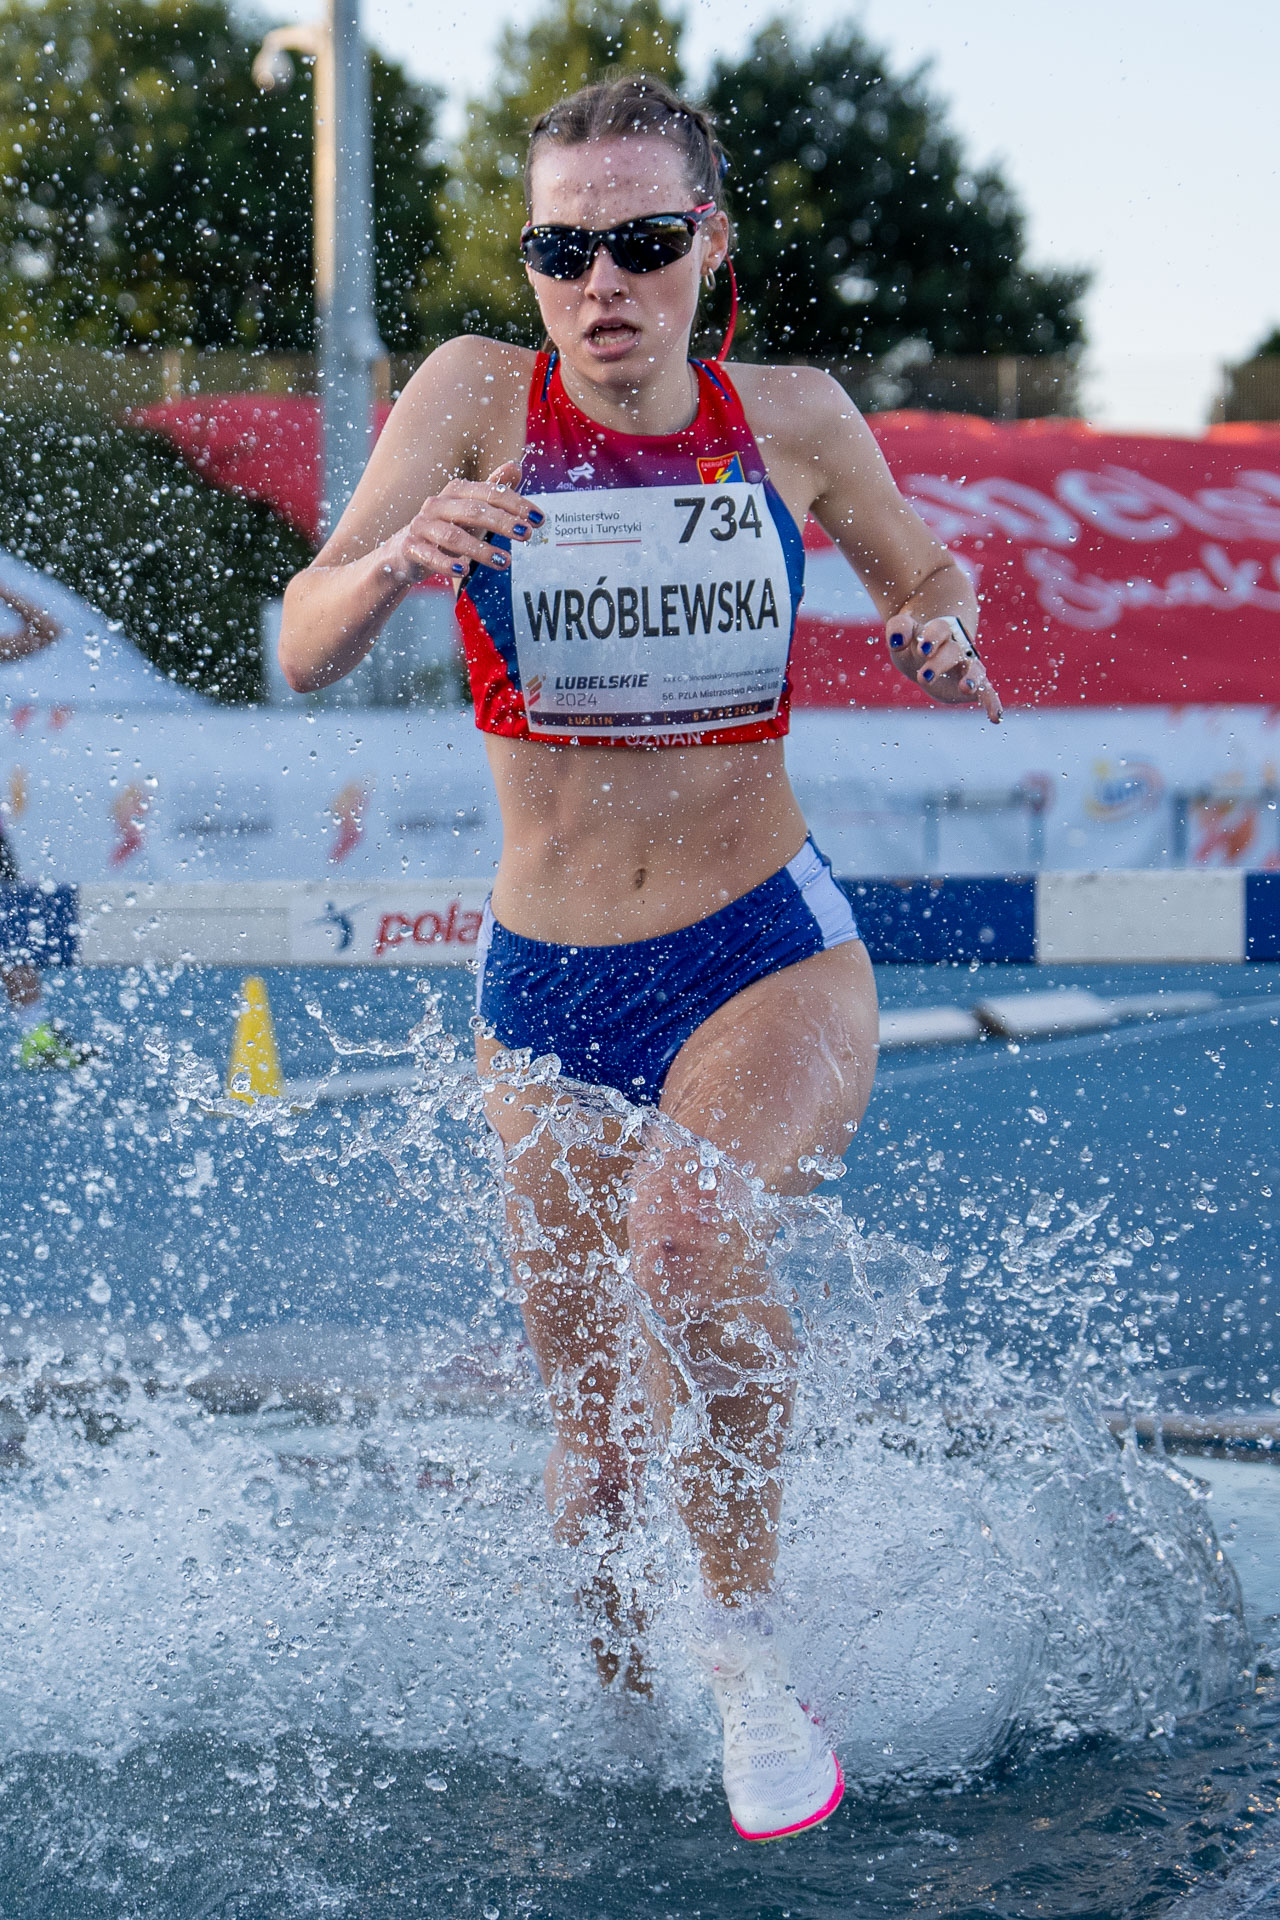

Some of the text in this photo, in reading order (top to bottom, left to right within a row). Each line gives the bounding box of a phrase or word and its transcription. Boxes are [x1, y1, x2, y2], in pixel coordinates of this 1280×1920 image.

[554, 511, 621, 524] Ministerstwo
[673, 494, 763, 544] 734
[554, 522, 642, 537] Sportu i Turystyki
[523, 576, 780, 642] WRÓBLEWSKA
[555, 674, 649, 690] LUBELSKIE
[556, 692, 598, 706] 2024
[567, 716, 614, 725] LUBLIN
